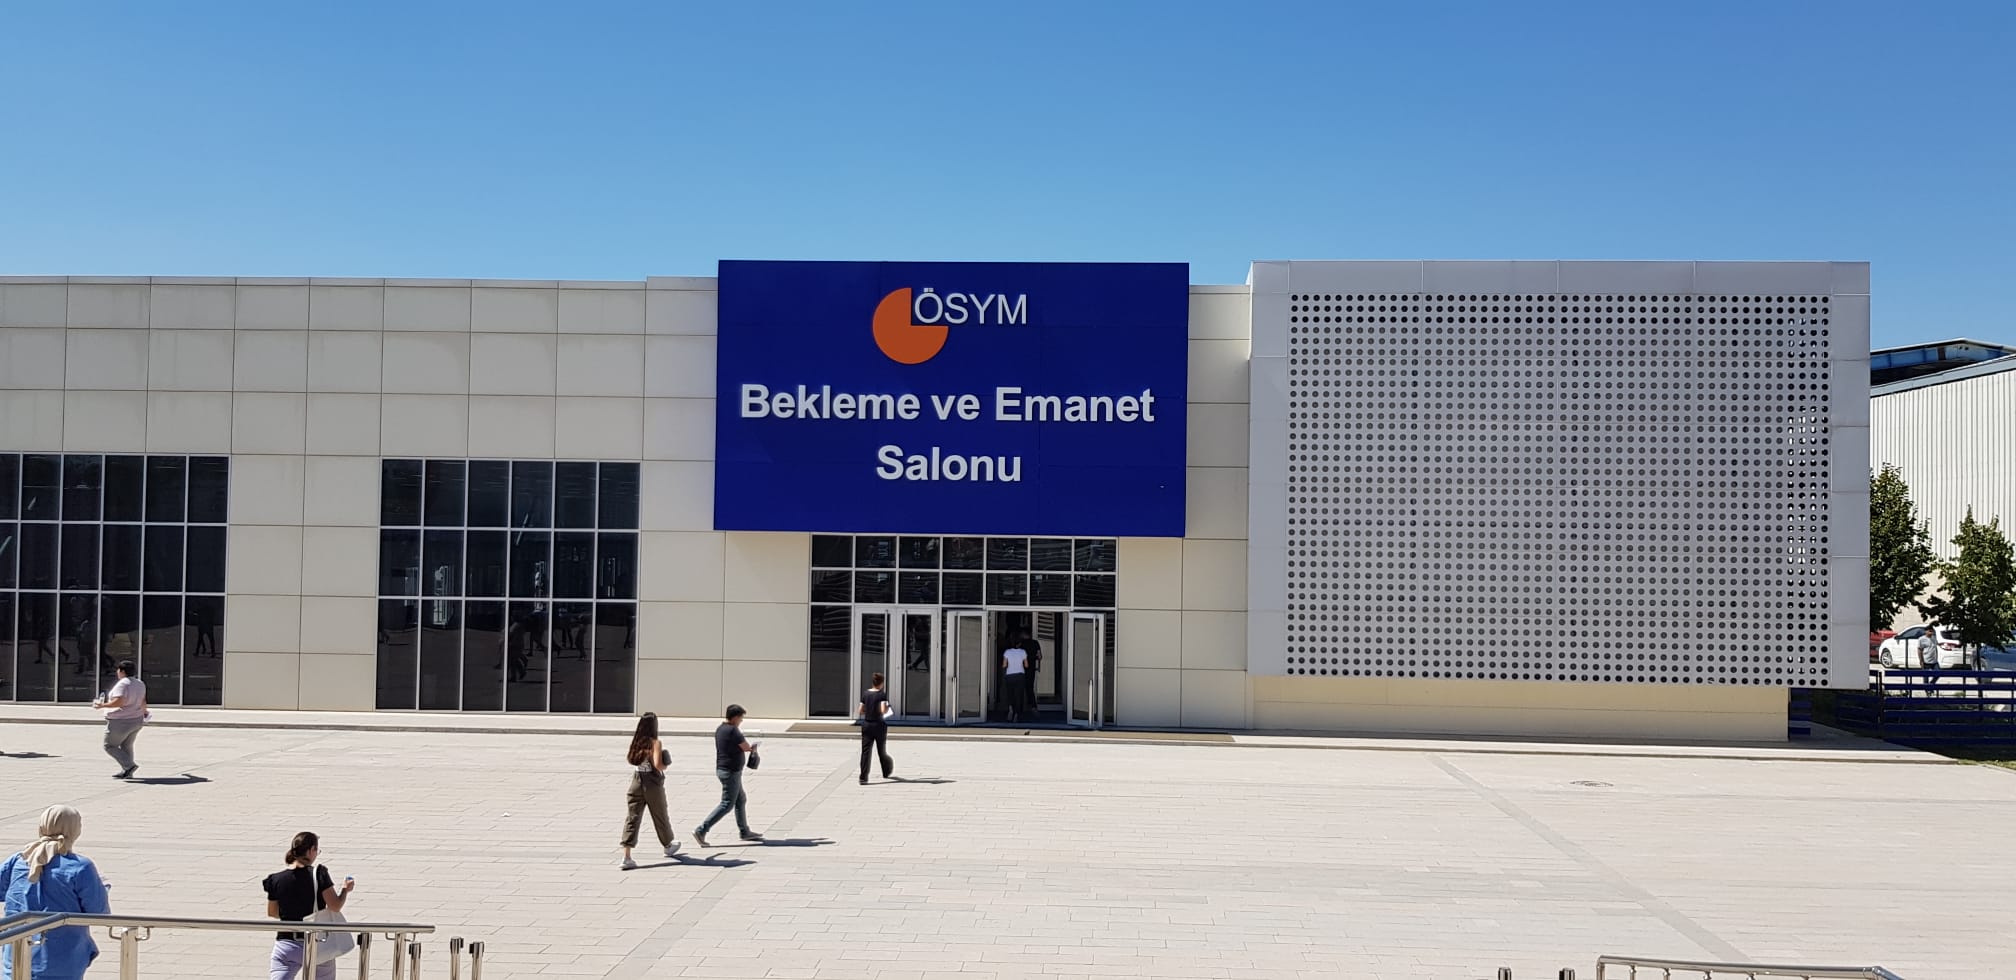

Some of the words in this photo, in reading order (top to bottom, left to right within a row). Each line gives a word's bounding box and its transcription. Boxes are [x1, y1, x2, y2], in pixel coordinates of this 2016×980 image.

[913, 287, 1028, 325] ÖSYM
[740, 383, 921, 420] Bekleme
[930, 394, 980, 421] ve
[995, 386, 1156, 423] Emanet
[876, 444, 1022, 482] Salonu
